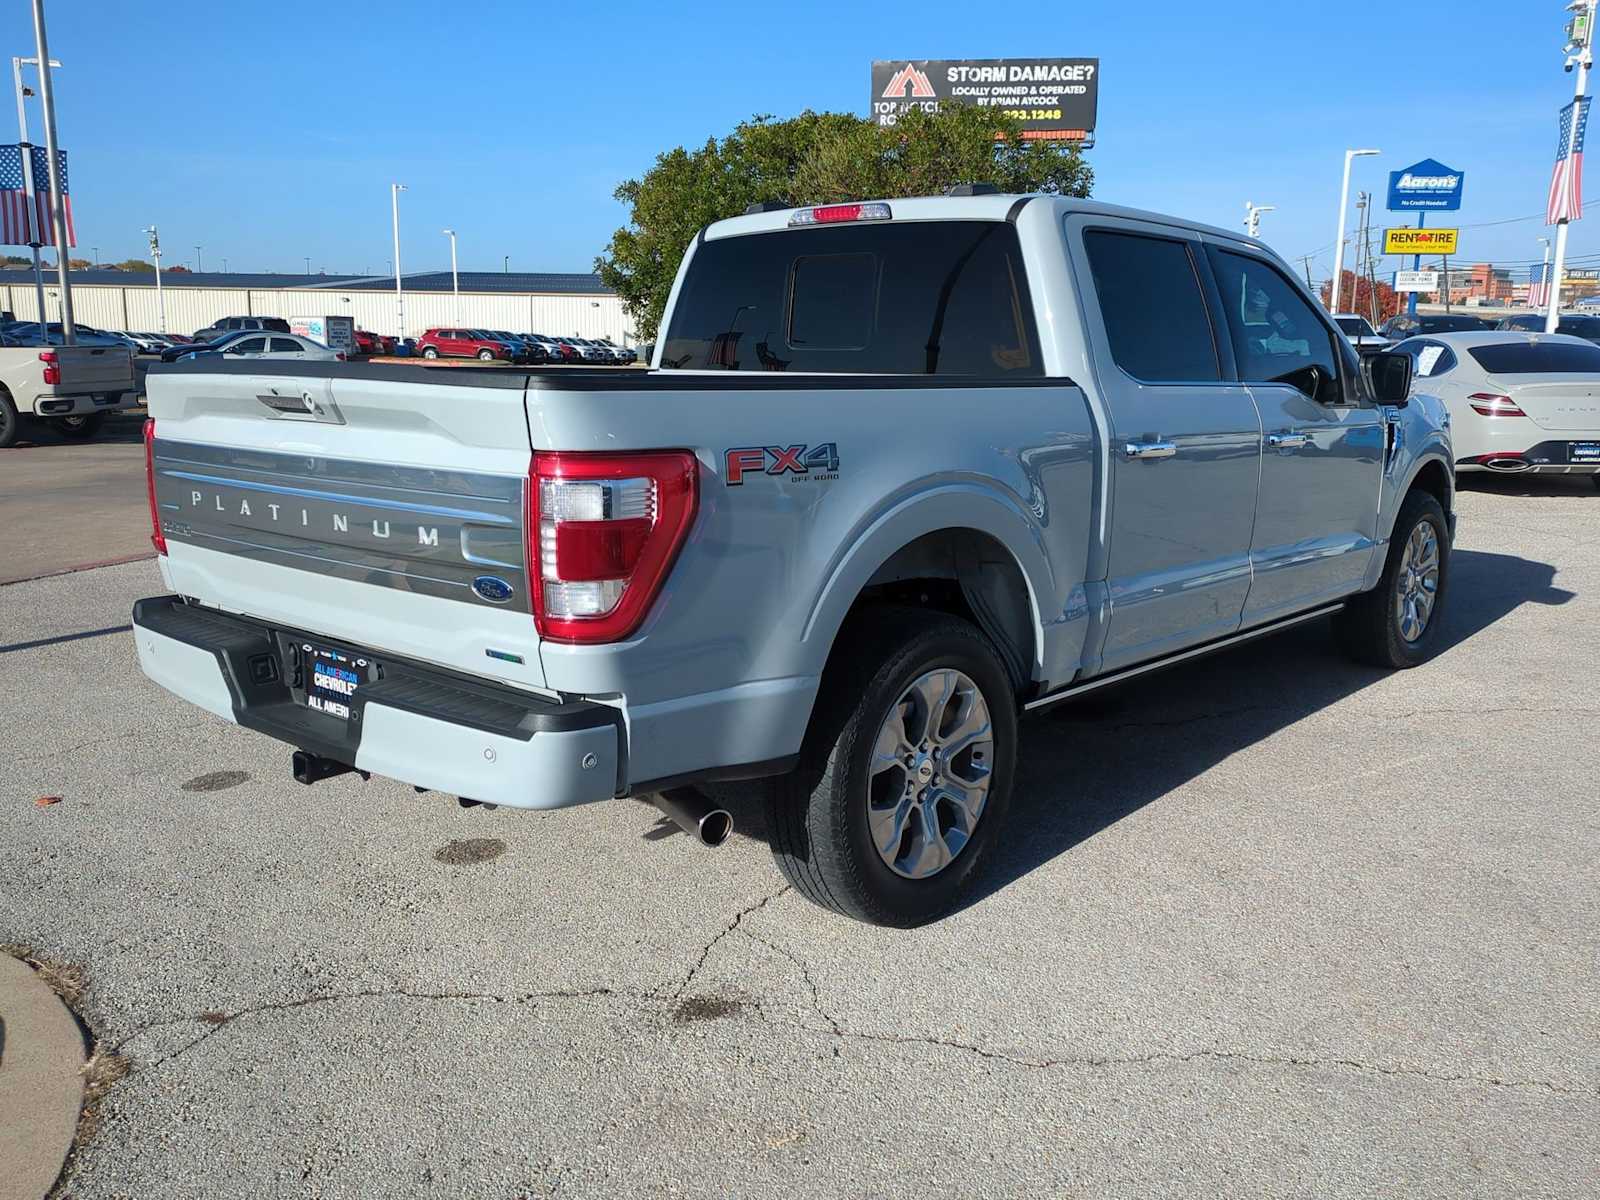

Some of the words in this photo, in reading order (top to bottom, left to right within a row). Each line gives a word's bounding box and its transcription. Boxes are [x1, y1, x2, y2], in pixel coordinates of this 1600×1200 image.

[947, 66, 1007, 82] STORM
[1009, 65, 1095, 81] DAMAGE?
[951, 86, 990, 96] LOCALLY
[991, 86, 1028, 96] OWNED
[1029, 86, 1037, 95] &
[1039, 85, 1087, 95] OPERATED
[874, 102, 897, 114] TOP
[977, 97, 989, 106] BY
[991, 96, 1020, 106] BRIAN
[1021, 96, 1059, 105] AYCOCK
[1397, 173, 1459, 188] Aaron's
[1391, 233, 1421, 243] RENT
[1428, 233, 1453, 243] TIRE
[724, 443, 840, 486] FX4
[191, 491, 439, 546] PLATINUM
[314, 663, 326, 675] ALL
[326, 666, 358, 684] AMERICAN
[308, 695, 323, 710] ALL
[324, 700, 350, 718] AMERI
